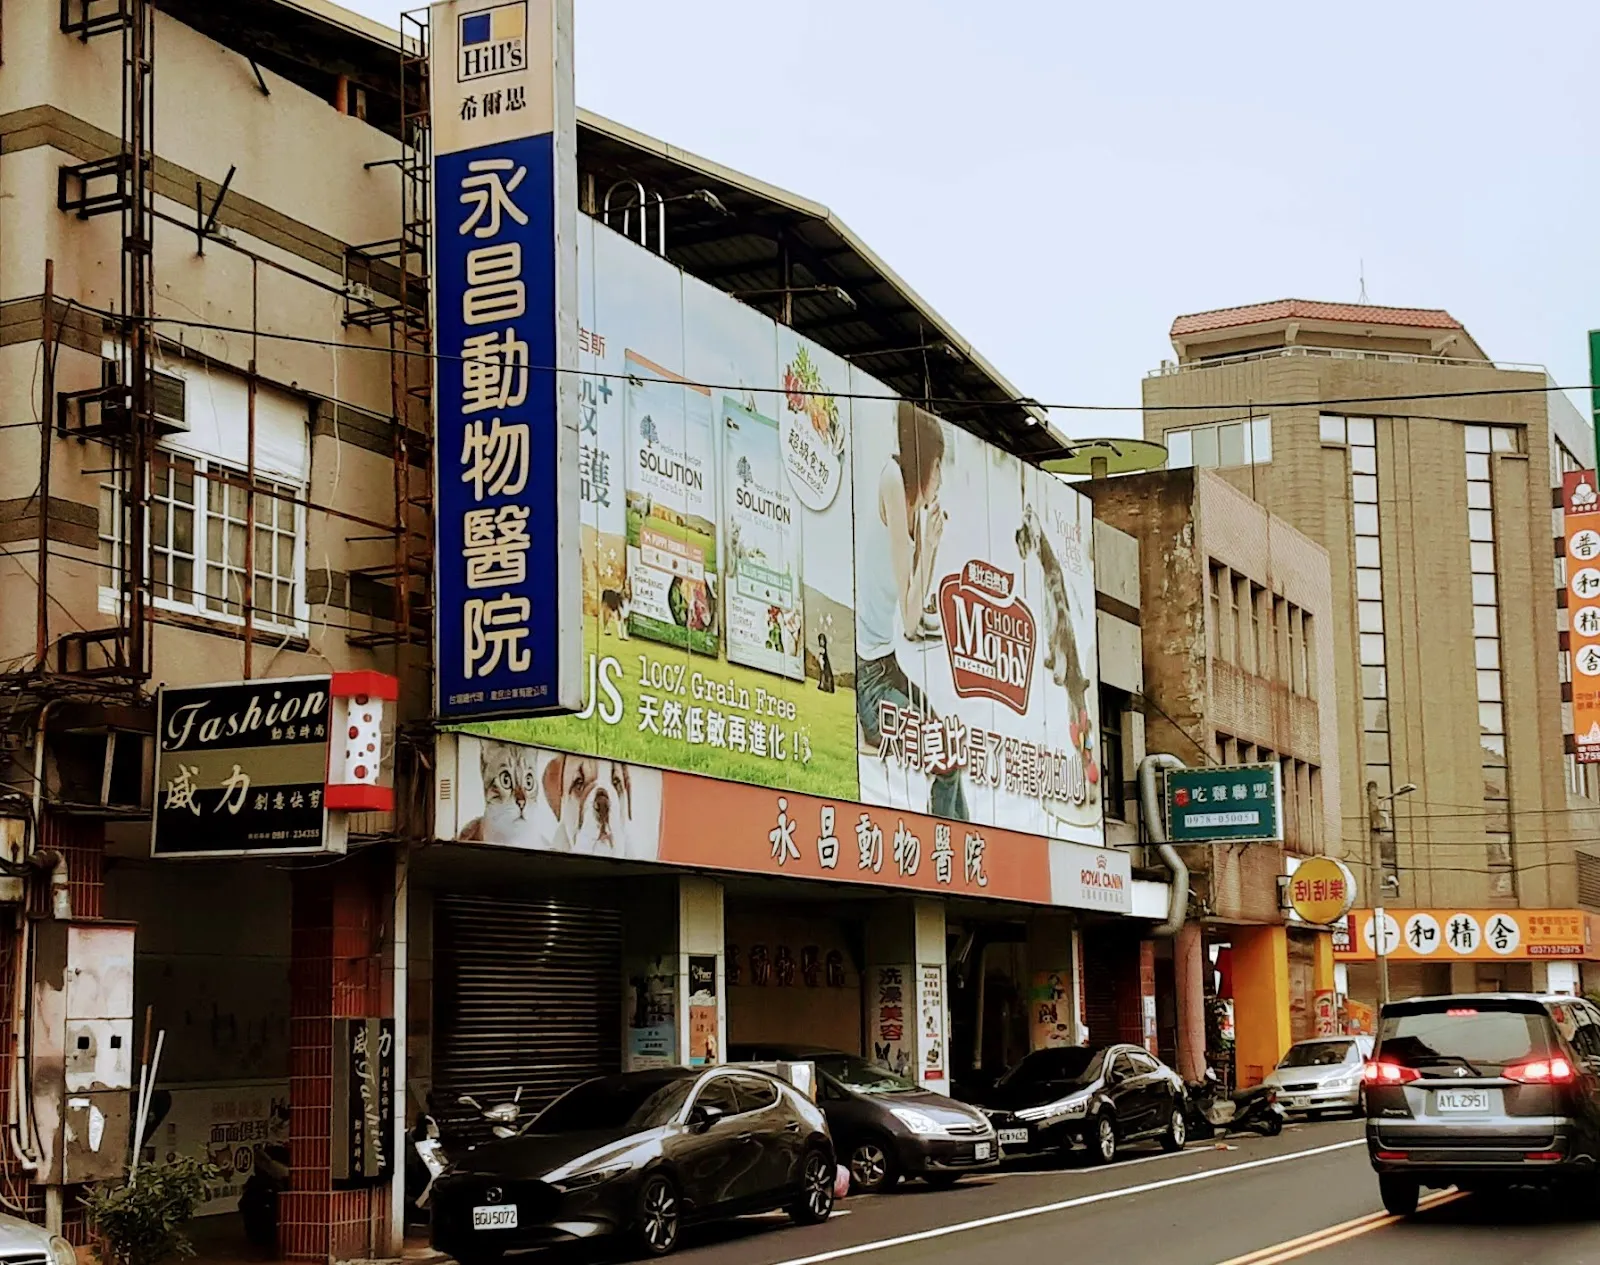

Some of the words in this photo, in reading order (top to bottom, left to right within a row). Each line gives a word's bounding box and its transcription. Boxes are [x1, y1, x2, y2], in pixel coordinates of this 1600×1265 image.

[463, 41, 522, 76] Hill's
[460, 86, 526, 120] 希爾思
[459, 158, 531, 680] 永昌動物醫院
[639, 448, 703, 491] SOLUTION
[736, 487, 791, 525] SOLUTION
[952, 594, 1030, 689] Mobby
[985, 608, 1030, 642] CHOICE
[638, 655, 686, 696] 100%
[692, 673, 749, 709] Grain
[755, 688, 796, 721] Free
[162, 690, 328, 750] Fashion
[164, 764, 250, 817] 威力
[1192, 782, 1268, 803] 吃雞聯盟
[768, 797, 988, 888] 永昌動物醫院
[1081, 868, 1102, 887] ROYAL
[1103, 872, 1124, 891] CANIN
[1294, 878, 1344, 902] 刮刮樂
[879, 967, 904, 1041] 洗澡美容
[353, 1026, 392, 1059] 威力
